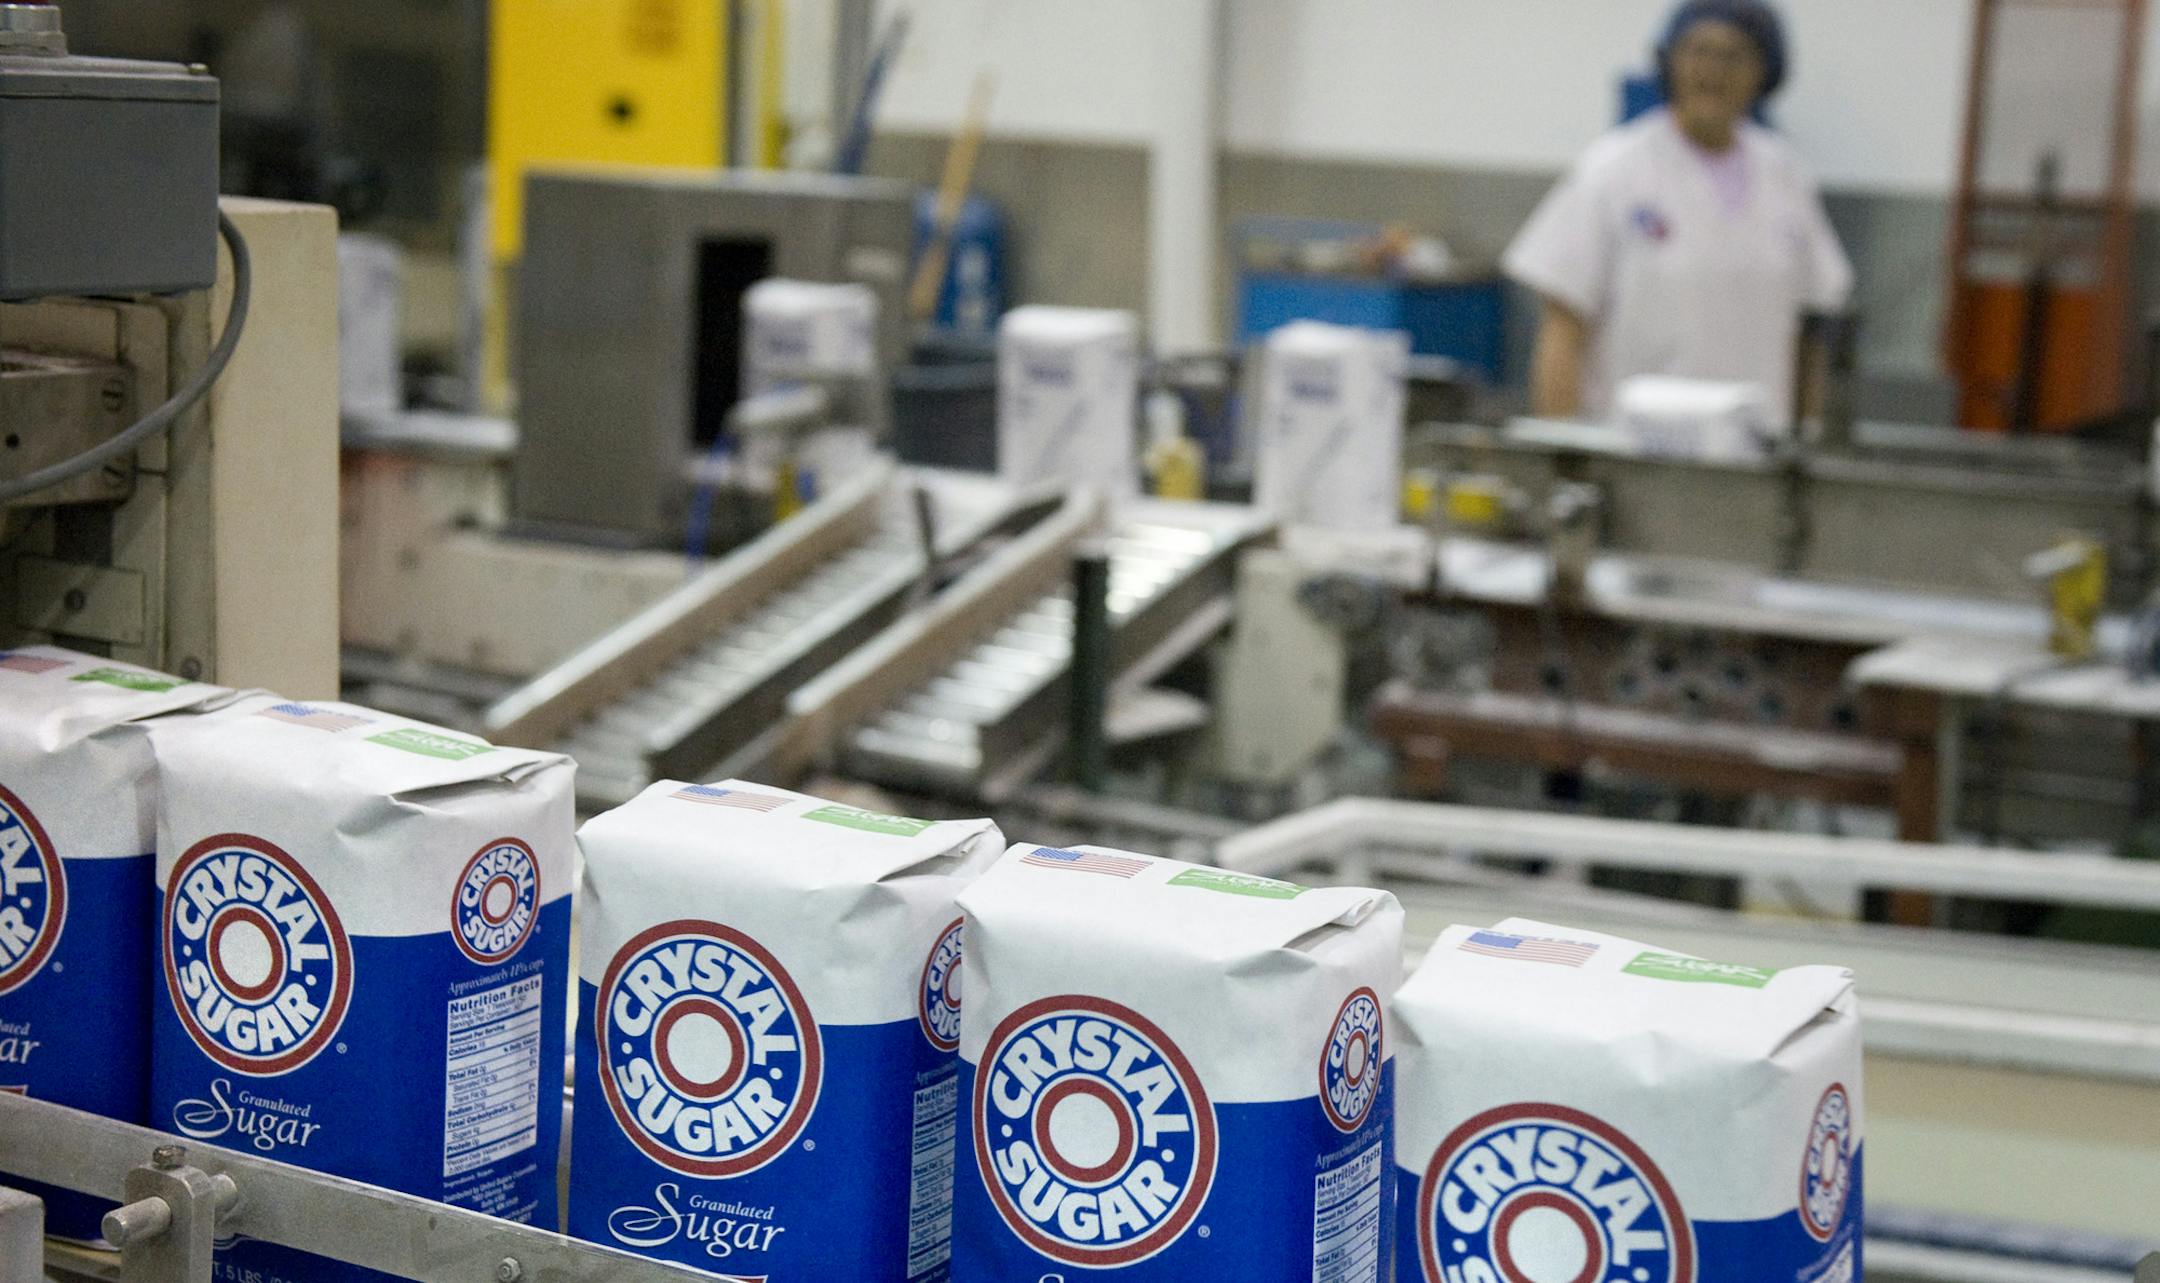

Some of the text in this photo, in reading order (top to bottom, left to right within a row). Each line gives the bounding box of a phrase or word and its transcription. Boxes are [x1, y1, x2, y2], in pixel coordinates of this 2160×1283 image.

[462, 848, 534, 908] CRYSTAL
[176, 855, 329, 972] CRYSTAL
[463, 902, 530, 952] SUGAR
[180, 960, 321, 1053] SUGAR
[450, 991, 507, 1013] Nutrition
[510, 979, 540, 997] Facts
[613, 942, 798, 1066] CRYSTAL
[929, 999, 960, 1038] SUG
[1330, 1000, 1378, 1068] CRYSTAL
[173, 1078, 321, 1150] Sugar
[239, 1090, 312, 1117] Granulated
[616, 1057, 786, 1153] SUGAR
[991, 1018, 1190, 1147] CRYSTAL
[1331, 1060, 1375, 1118] SUGAR
[996, 1140, 1180, 1241] SUGAR
[1317, 1163, 1359, 1189] Nutrition
[1361, 1147, 1380, 1168] Facts
[1441, 1127, 1666, 1267] CRYSTAL
[607, 1182, 786, 1258] Sugar
[689, 1194, 775, 1221] Granulated
[226, 1265, 235, 1280] 5
[238, 1267, 261, 1283] LBS
